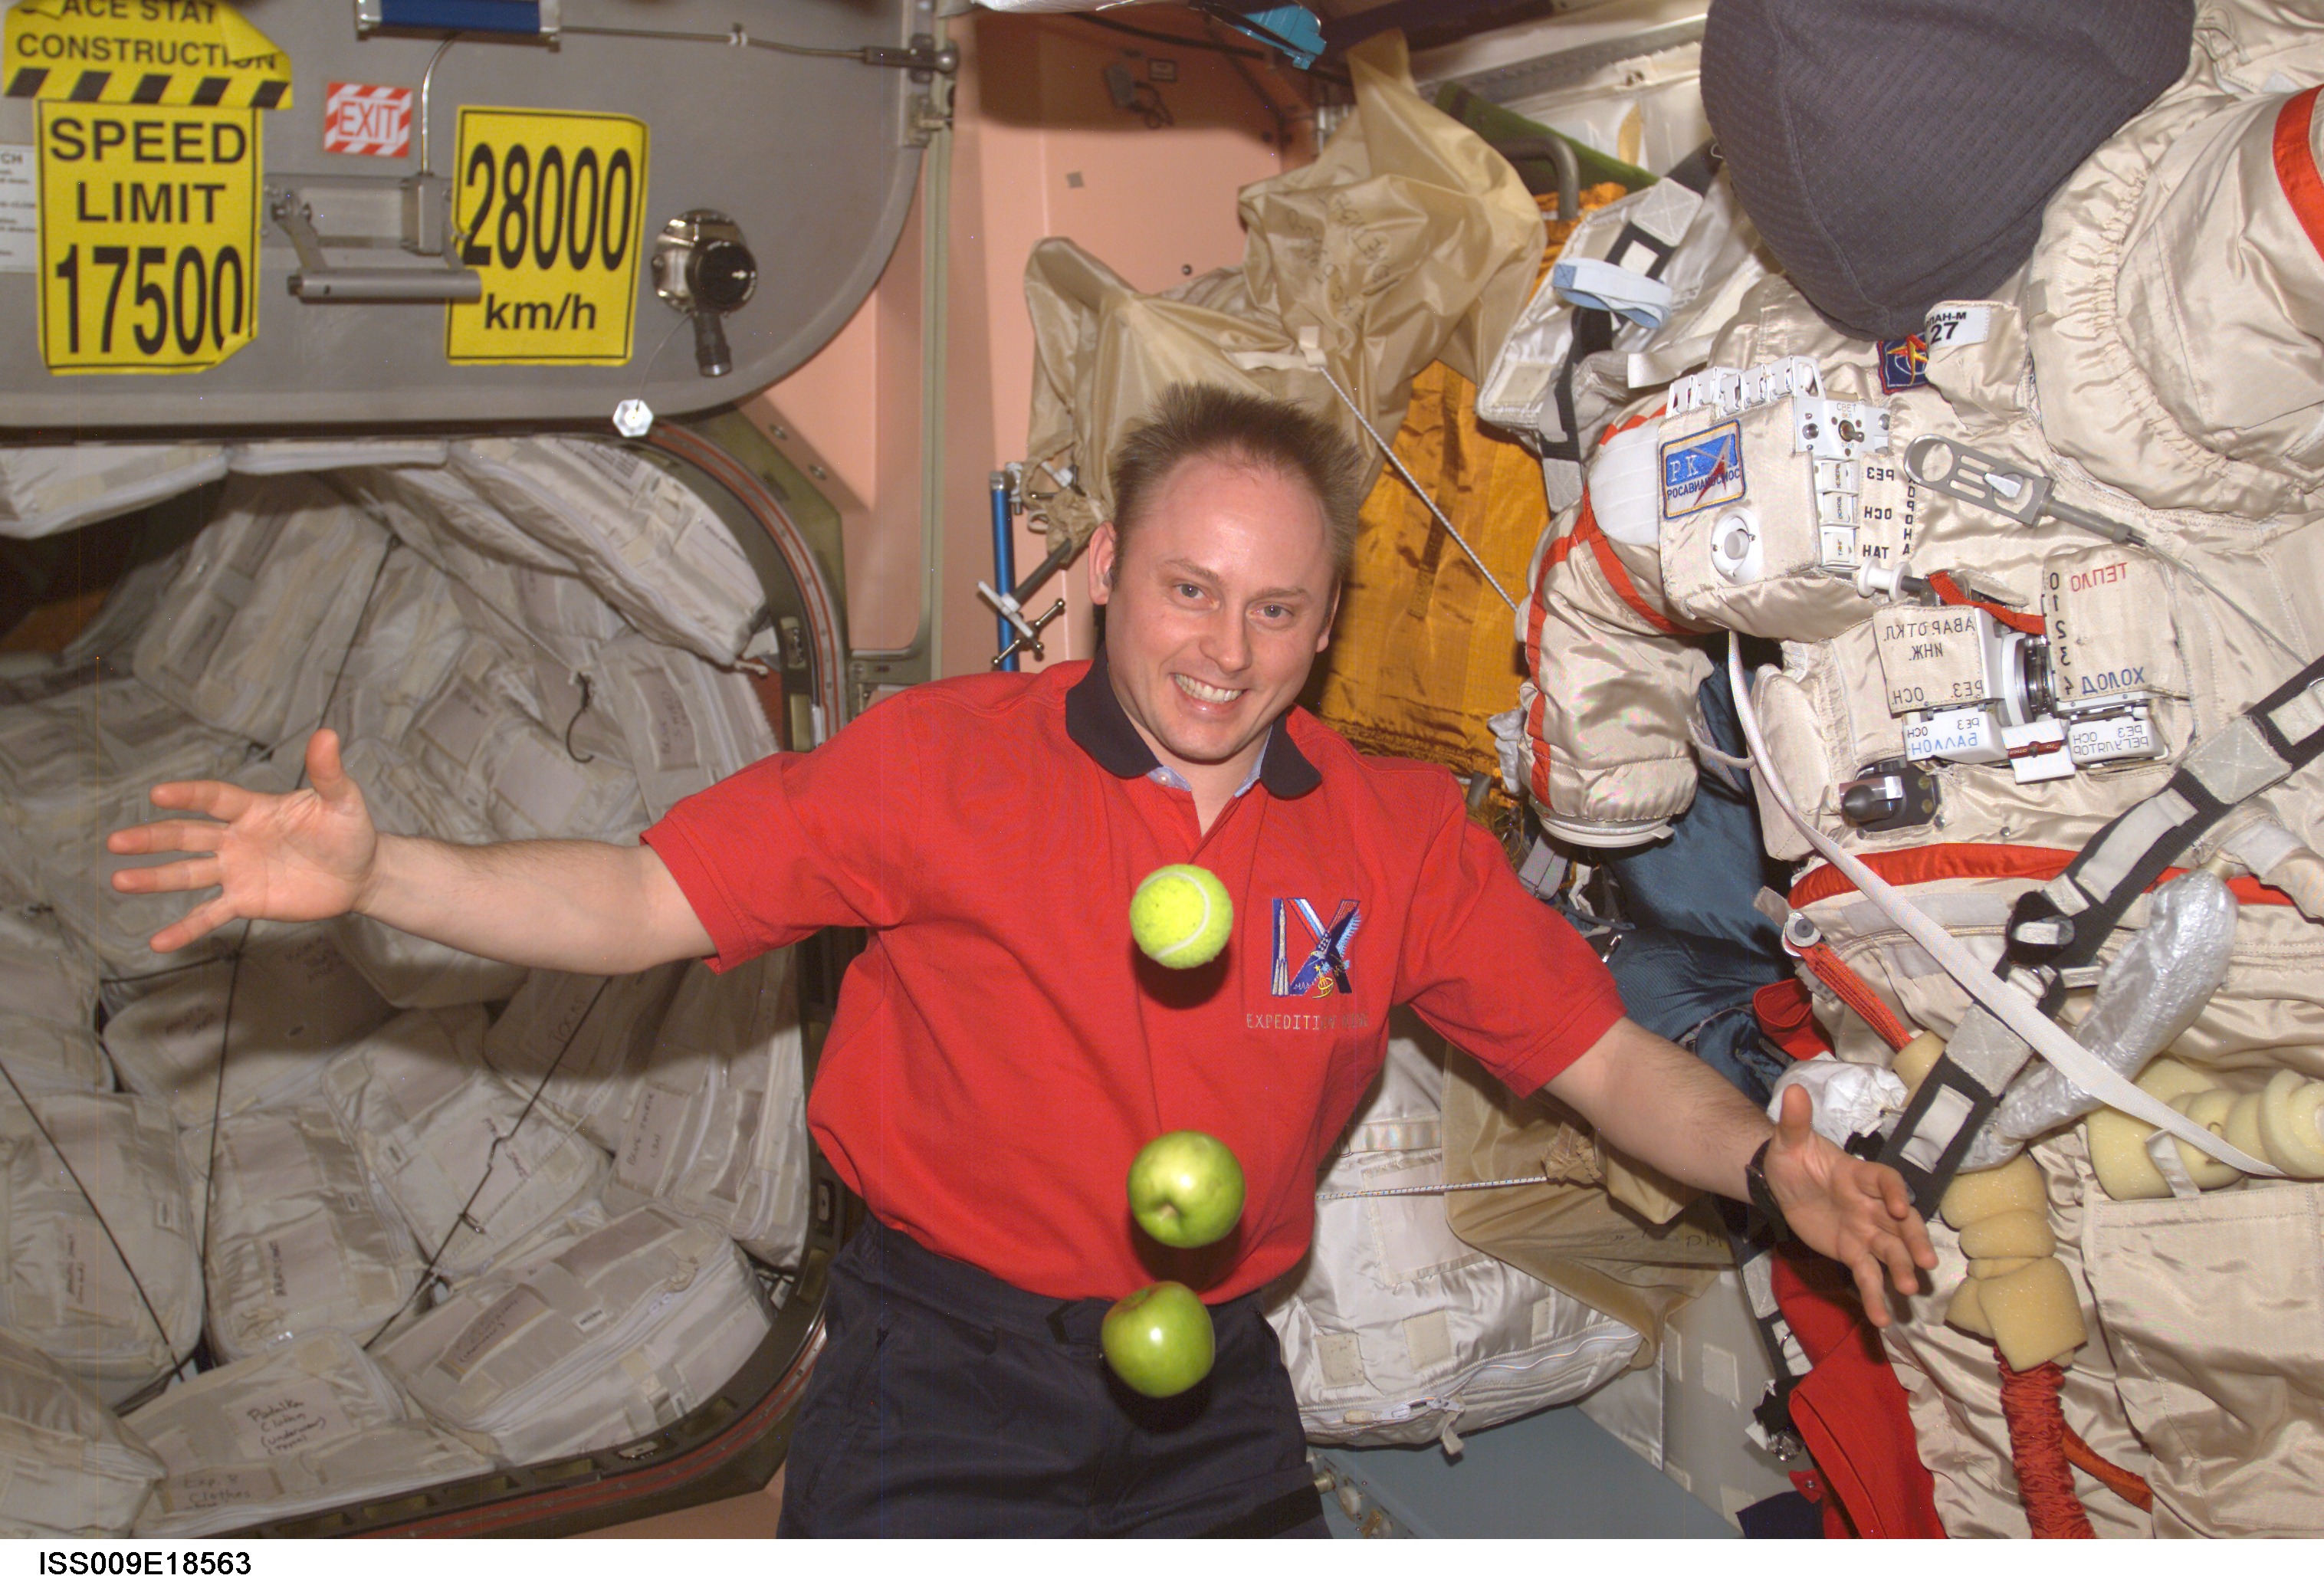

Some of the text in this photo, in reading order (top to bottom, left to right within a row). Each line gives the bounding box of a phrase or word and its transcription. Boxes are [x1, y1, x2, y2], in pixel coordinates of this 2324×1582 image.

[20, 0, 215, 25] ACE STAT
[338, 100, 399, 139] EXIT
[50, 117, 247, 165] SPEED
[77, 181, 227, 224] LIMIT
[462, 142, 633, 271] 28000
[55, 244, 244, 356] 17500
[484, 292, 597, 331] km/h
[1930, 321, 1959, 345] 27
